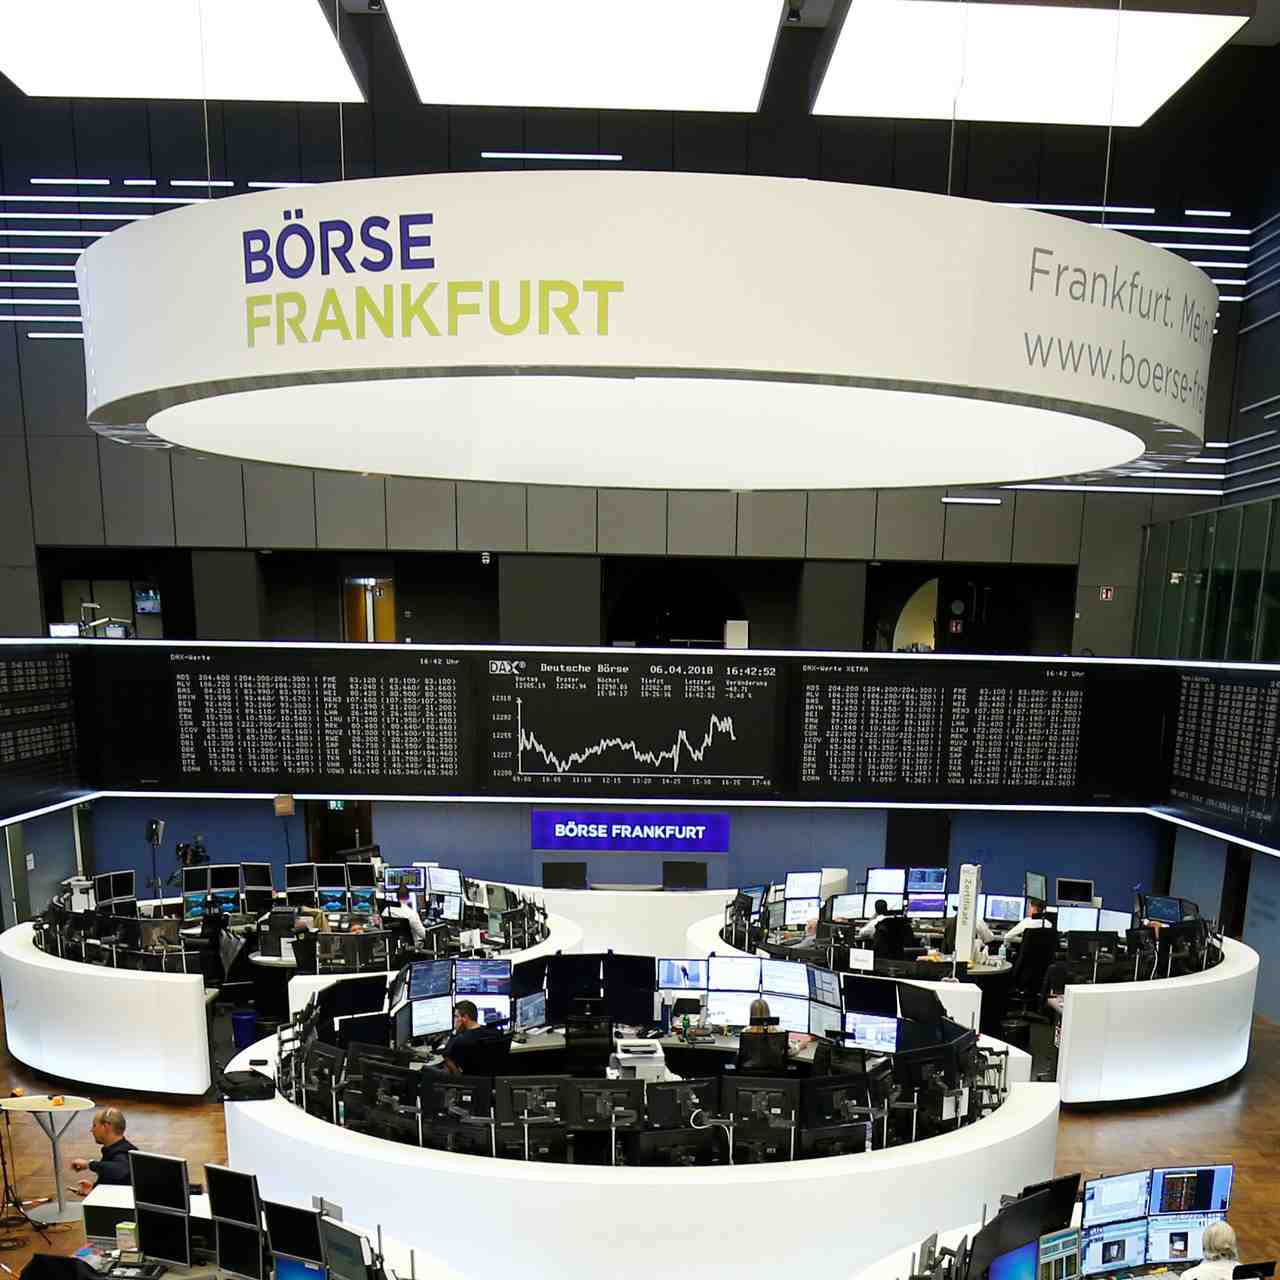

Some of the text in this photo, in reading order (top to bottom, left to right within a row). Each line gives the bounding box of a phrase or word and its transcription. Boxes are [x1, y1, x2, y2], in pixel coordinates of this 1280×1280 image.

[244, 211, 433, 284] BÖRSE
[245, 278, 625, 346] FRANKFURT
[1029, 246, 1174, 329] Frankfurt.
[540, 663, 592, 673] Deutsche
[597, 663, 629, 673] Börse
[650, 665, 713, 675] 06.04.2018
[725, 666, 776, 676] 16:42:52
[555, 821, 706, 839] BÖRSE FRANKFURT
